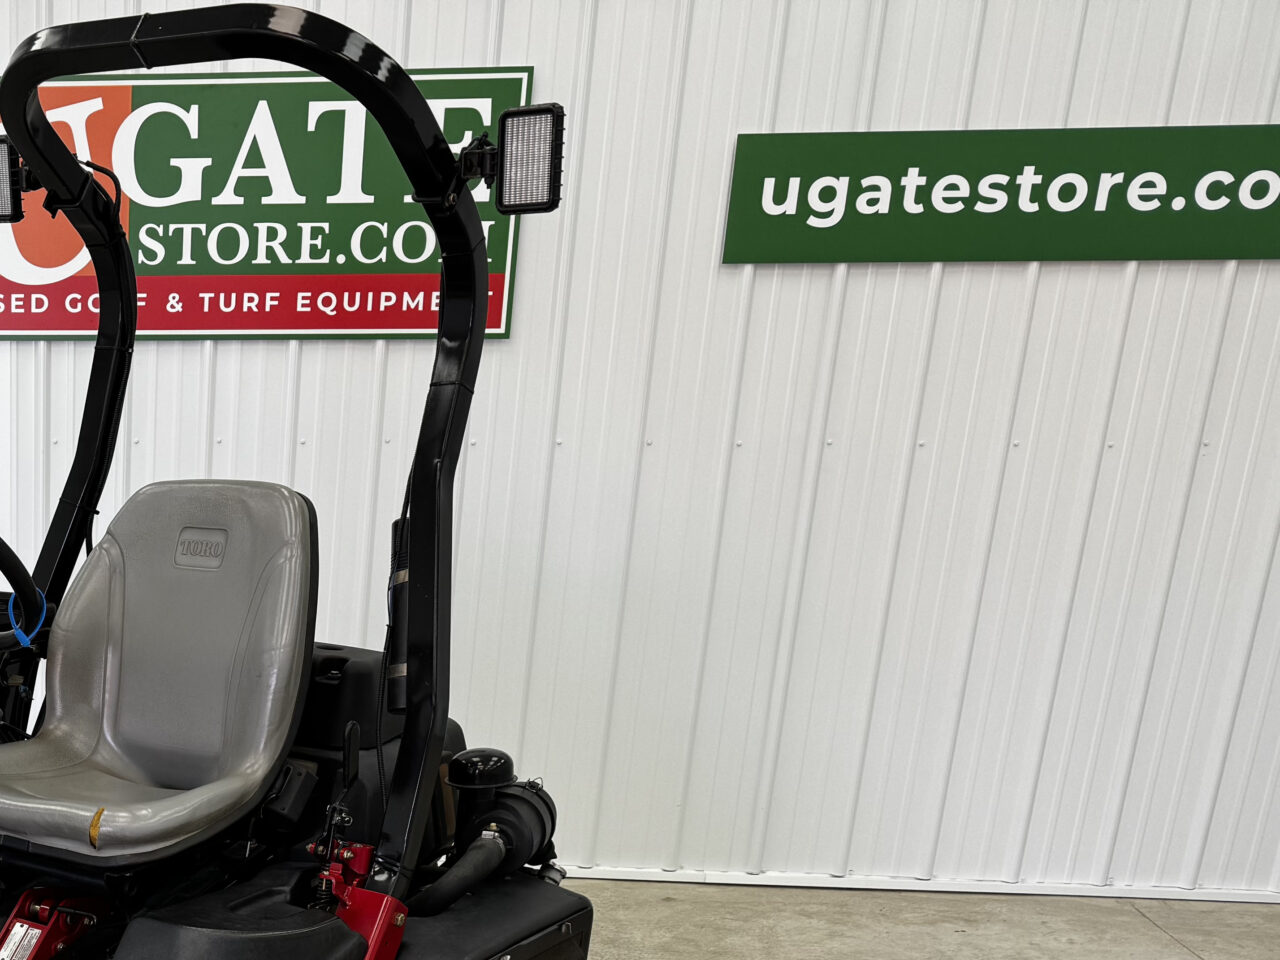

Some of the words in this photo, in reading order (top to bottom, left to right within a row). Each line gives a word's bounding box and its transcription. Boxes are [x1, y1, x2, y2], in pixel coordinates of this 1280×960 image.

[165, 292, 183, 313] &
[198, 291, 281, 313] TURF
[296, 290, 494, 316] EQUIPME
[180, 538, 224, 559] TORO
